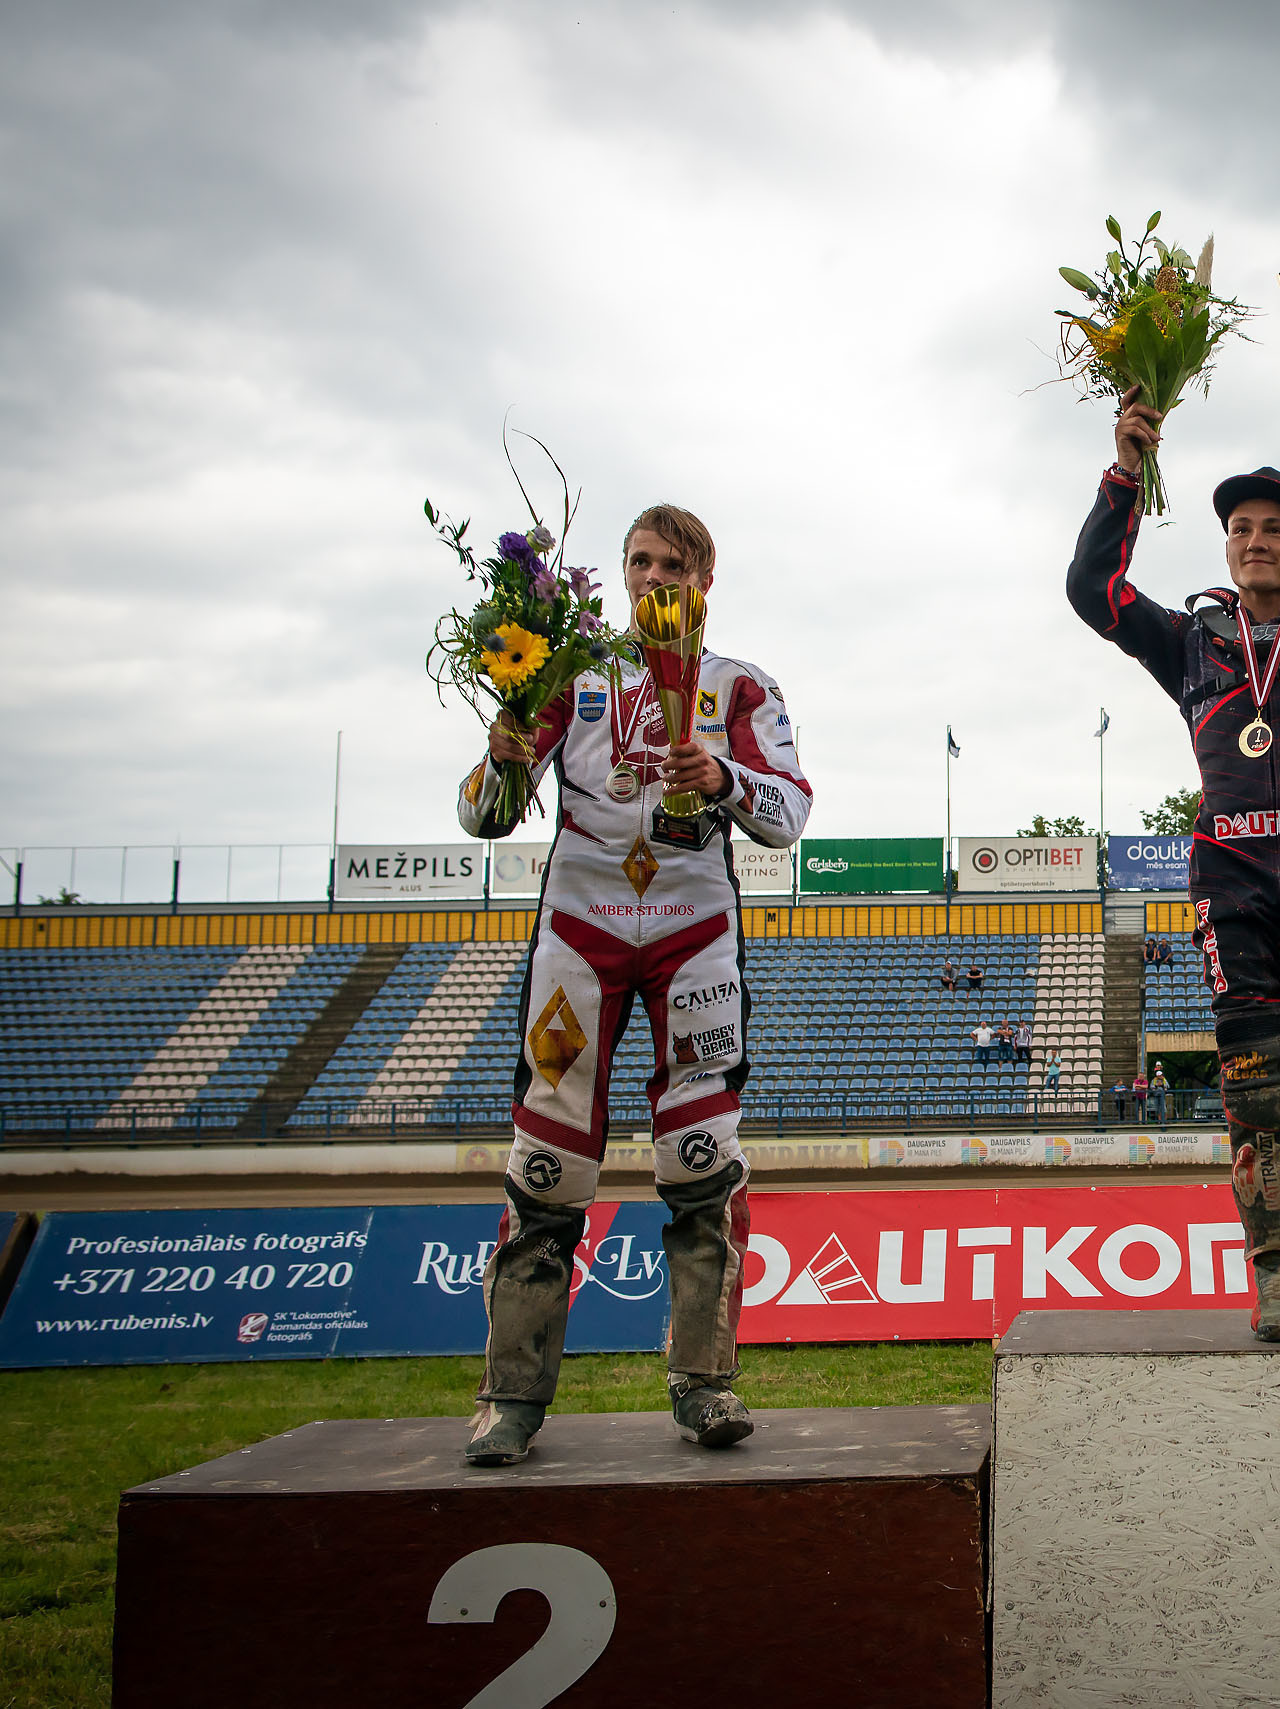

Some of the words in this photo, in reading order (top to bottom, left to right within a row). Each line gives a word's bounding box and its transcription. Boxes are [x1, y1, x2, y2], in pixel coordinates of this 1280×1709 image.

[1004, 848, 1083, 866] OPTIBET
[1127, 841, 1192, 861] dautk
[347, 852, 473, 878] MEŽPILS
[740, 854, 765, 863] JOY
[770, 854, 788, 863] OF
[806, 857, 849, 874] Carlsberg
[734, 868, 779, 877] RITING
[587, 904, 634, 916] AMBER
[636, 904, 695, 916] STUDIOS
[767, 912, 777, 923] M
[701, 1036, 736, 1057] BEAR
[907, 1140, 946, 1148] DAUGAVPILS
[990, 1138, 1031, 1146] DAUGAVPILS
[1157, 1136, 1198, 1144] DAUGAVPILS
[66, 1235, 246, 1255] Profesionālais
[252, 1230, 368, 1254] fotogrāfs
[53, 1267, 136, 1295] +371
[141, 1265, 215, 1293] 220
[224, 1264, 275, 1291] 40
[286, 1262, 354, 1289] 720
[36, 1313, 214, 1333] www.rubenis.lv
[274, 1312, 287, 1320] SK
[270, 1322, 322, 1331] komandas
[427, 1543, 617, 1709] 2
